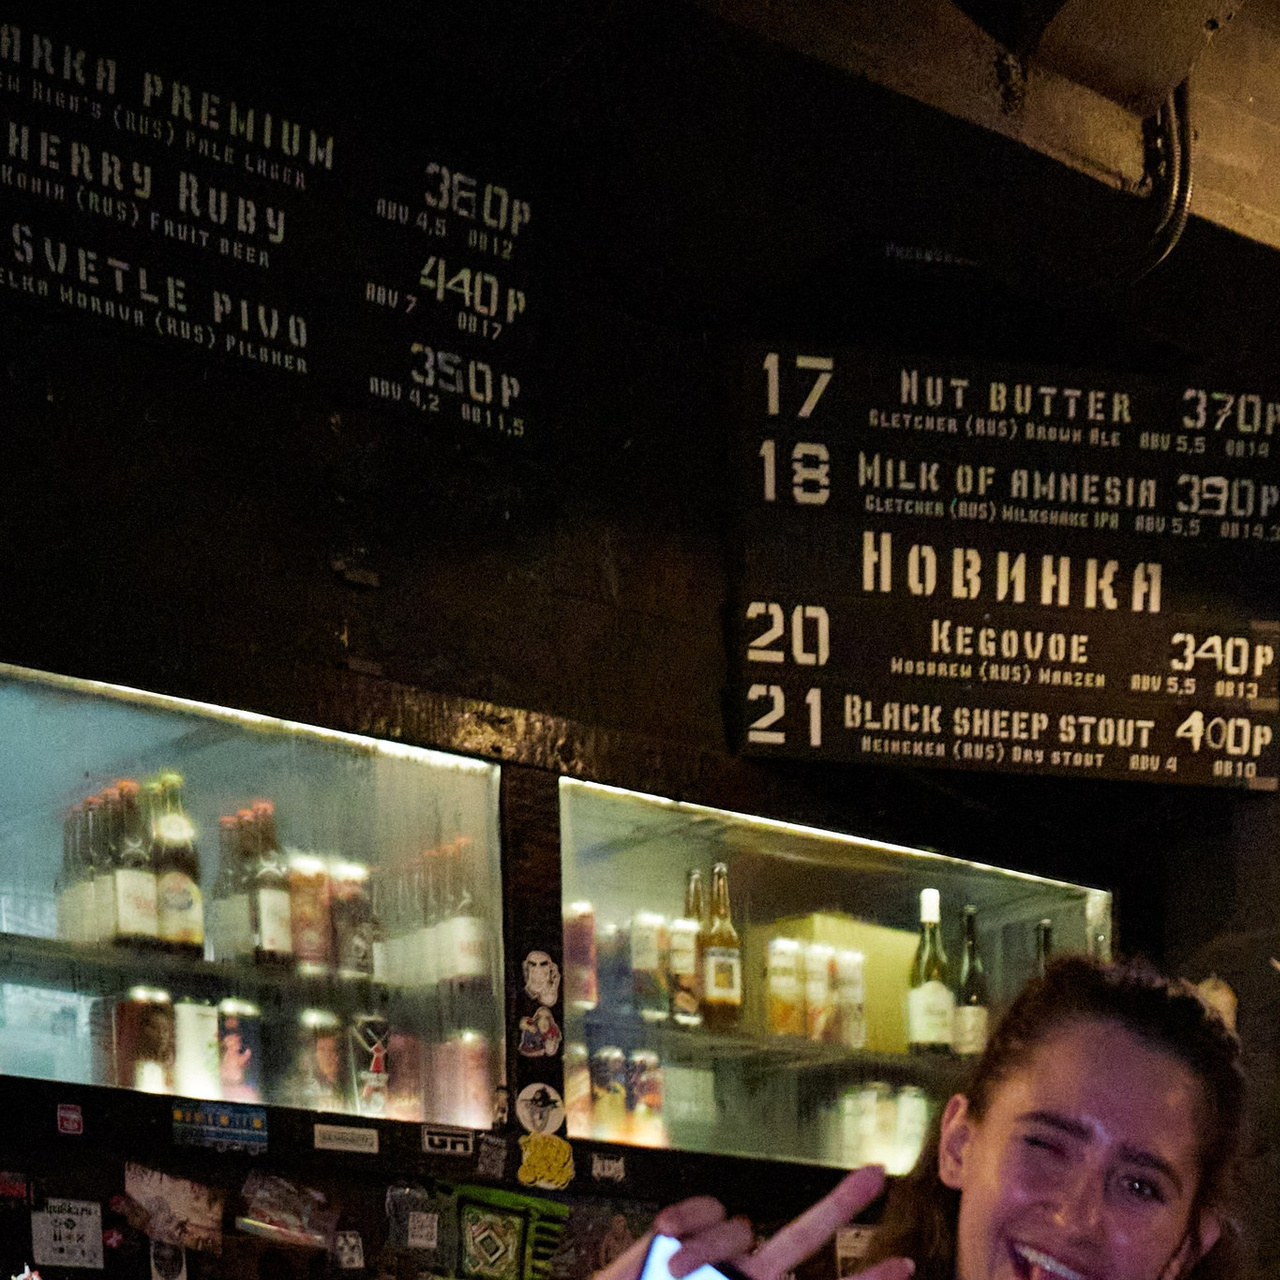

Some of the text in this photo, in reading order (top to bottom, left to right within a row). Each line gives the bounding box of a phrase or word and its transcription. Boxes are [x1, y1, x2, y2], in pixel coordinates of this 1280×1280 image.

[143, 72, 333, 170] PREMIUM
[9, 121, 285, 244] HERRY RUBY
[186, 131, 233, 164] PALE
[245, 154, 305, 190] LAGER
[77, 185, 139, 227] (RUS)
[150, 211, 209, 247] FRUIT
[220, 237, 269, 268] BEER
[12, 223, 307, 348] SVETLE PIVO
[405, 294, 418, 313] 7
[155, 310, 215, 349] (RUS)
[763, 352, 834, 418] 17
[900, 369, 969, 409] NUT
[989, 382, 1132, 424] BUTTER
[869, 408, 958, 434] GLETCHER
[965, 414, 1018, 440] (RUS)
[1025, 421, 1082, 443] BROWN
[1089, 428, 1121, 447] ALE
[759, 439, 830, 505] 18
[857, 451, 940, 492] MILK
[955, 464, 996, 496] OF
[1010, 468, 1156, 509] AMNESIA
[864, 494, 945, 517] GLETCHER
[949, 498, 997, 523] (RUS)
[1001, 504, 1089, 528] MILKSHAKE
[1094, 511, 1120, 530] IPA
[862, 529, 1163, 614] НОВИНКА
[746, 601, 830, 666] 20
[930, 618, 1090, 664] KEGOVOE
[978, 660, 1032, 685] (RUS)
[747, 683, 822, 748] 21
[843, 693, 942, 734] BLACK
[953, 706, 1049, 741] SHEEP
[1058, 714, 1156, 749] STOUT
[861, 735, 946, 757] HEINEKEN
[953, 739, 1005, 764] (RUS)
[1011, 745, 1045, 765] DRY
[1051, 750, 1104, 768] STOUT
[1165, 755, 1178, 773] 4
